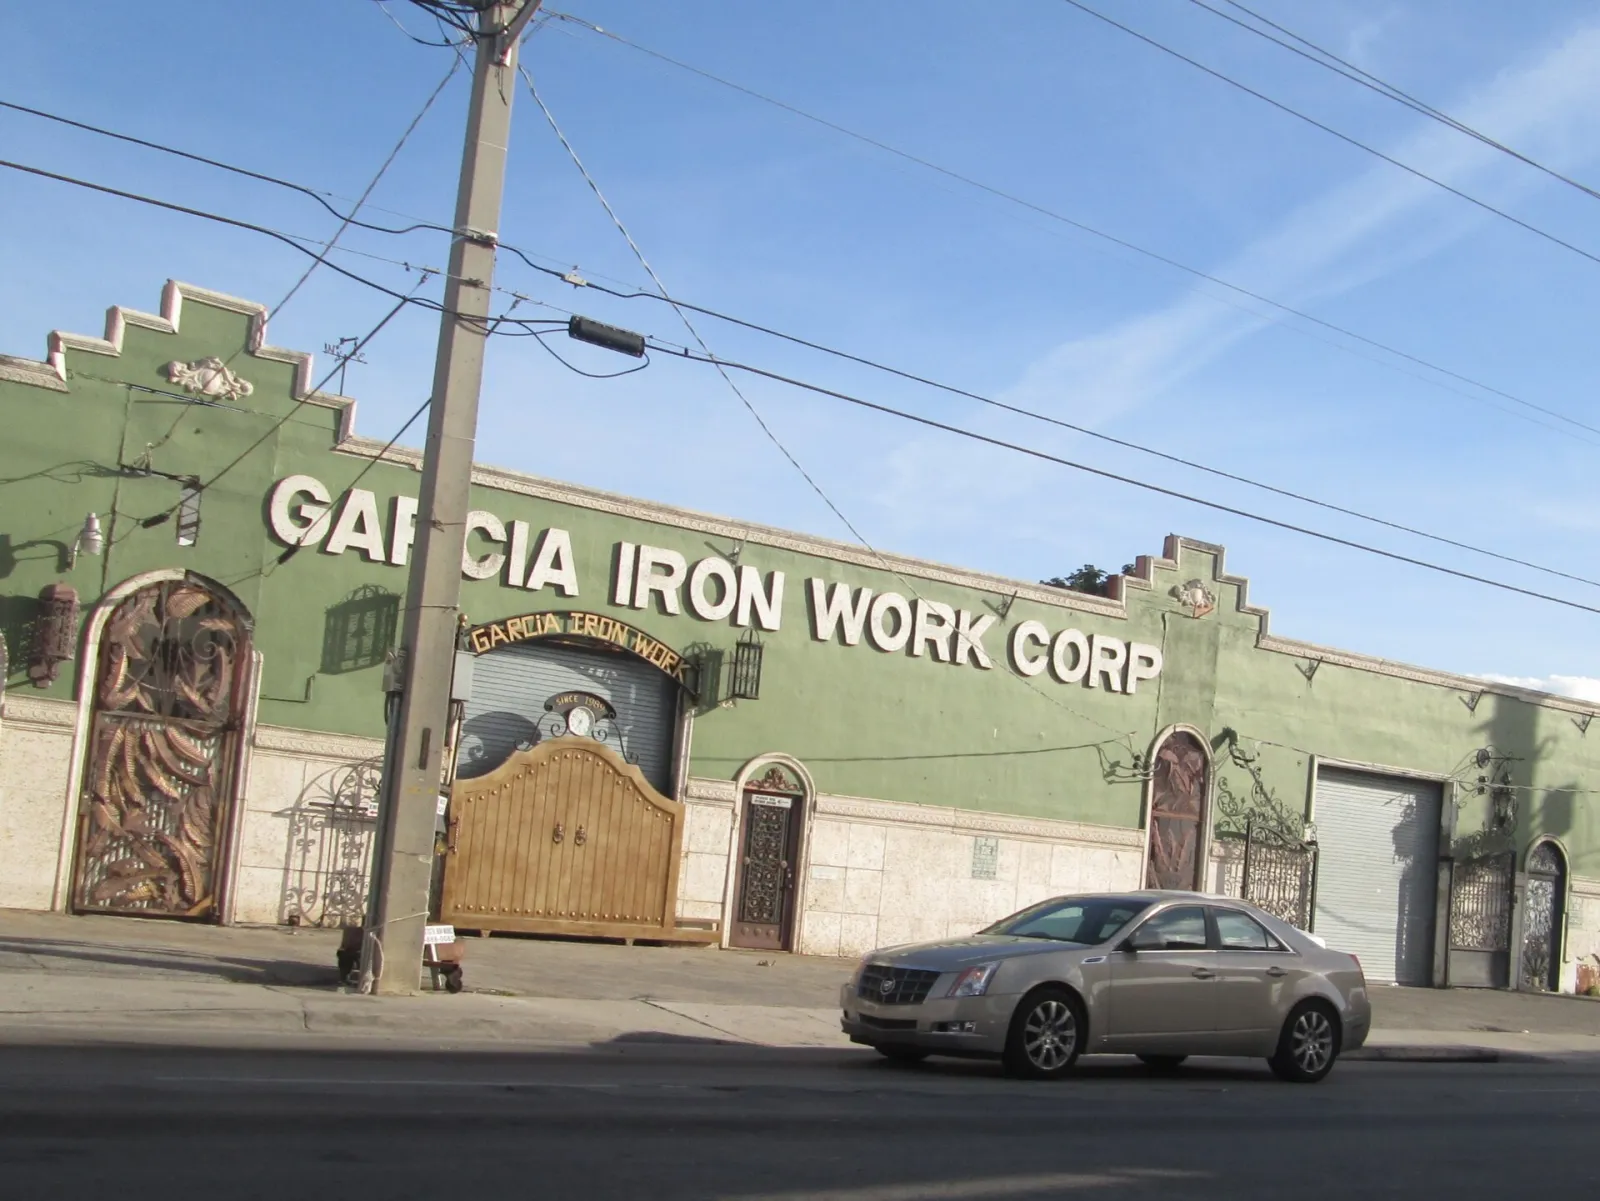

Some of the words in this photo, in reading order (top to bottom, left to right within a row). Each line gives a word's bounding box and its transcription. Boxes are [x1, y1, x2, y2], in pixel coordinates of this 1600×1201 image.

[570, 612, 629, 646] IRON
[635, 631, 691, 684] WORK
[614, 541, 785, 631] IRON
[810, 578, 997, 669] WORK
[1012, 620, 1163, 694] CORP
[556, 695, 579, 705] SINCE
